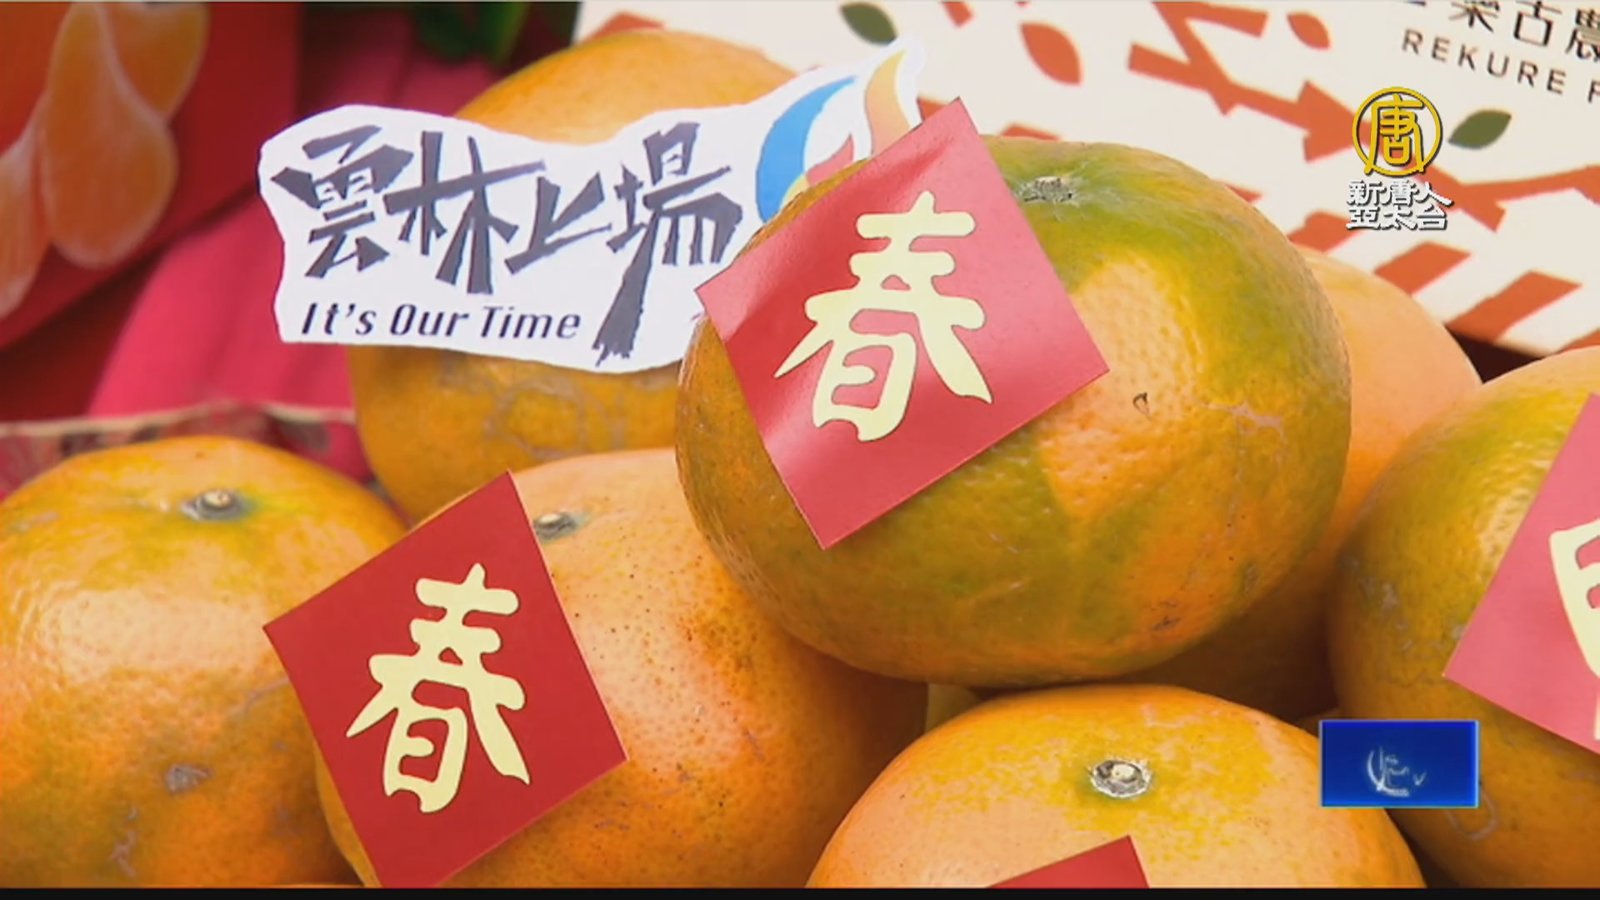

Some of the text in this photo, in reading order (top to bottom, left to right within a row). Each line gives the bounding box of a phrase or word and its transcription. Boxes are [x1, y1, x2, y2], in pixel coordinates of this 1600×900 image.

[1402, 28, 1567, 95] REKURE
[271, 121, 744, 367] 雲林上場
[301, 302, 581, 341] It's Our Time
[773, 190, 993, 442] 春
[345, 562, 531, 813] 春
